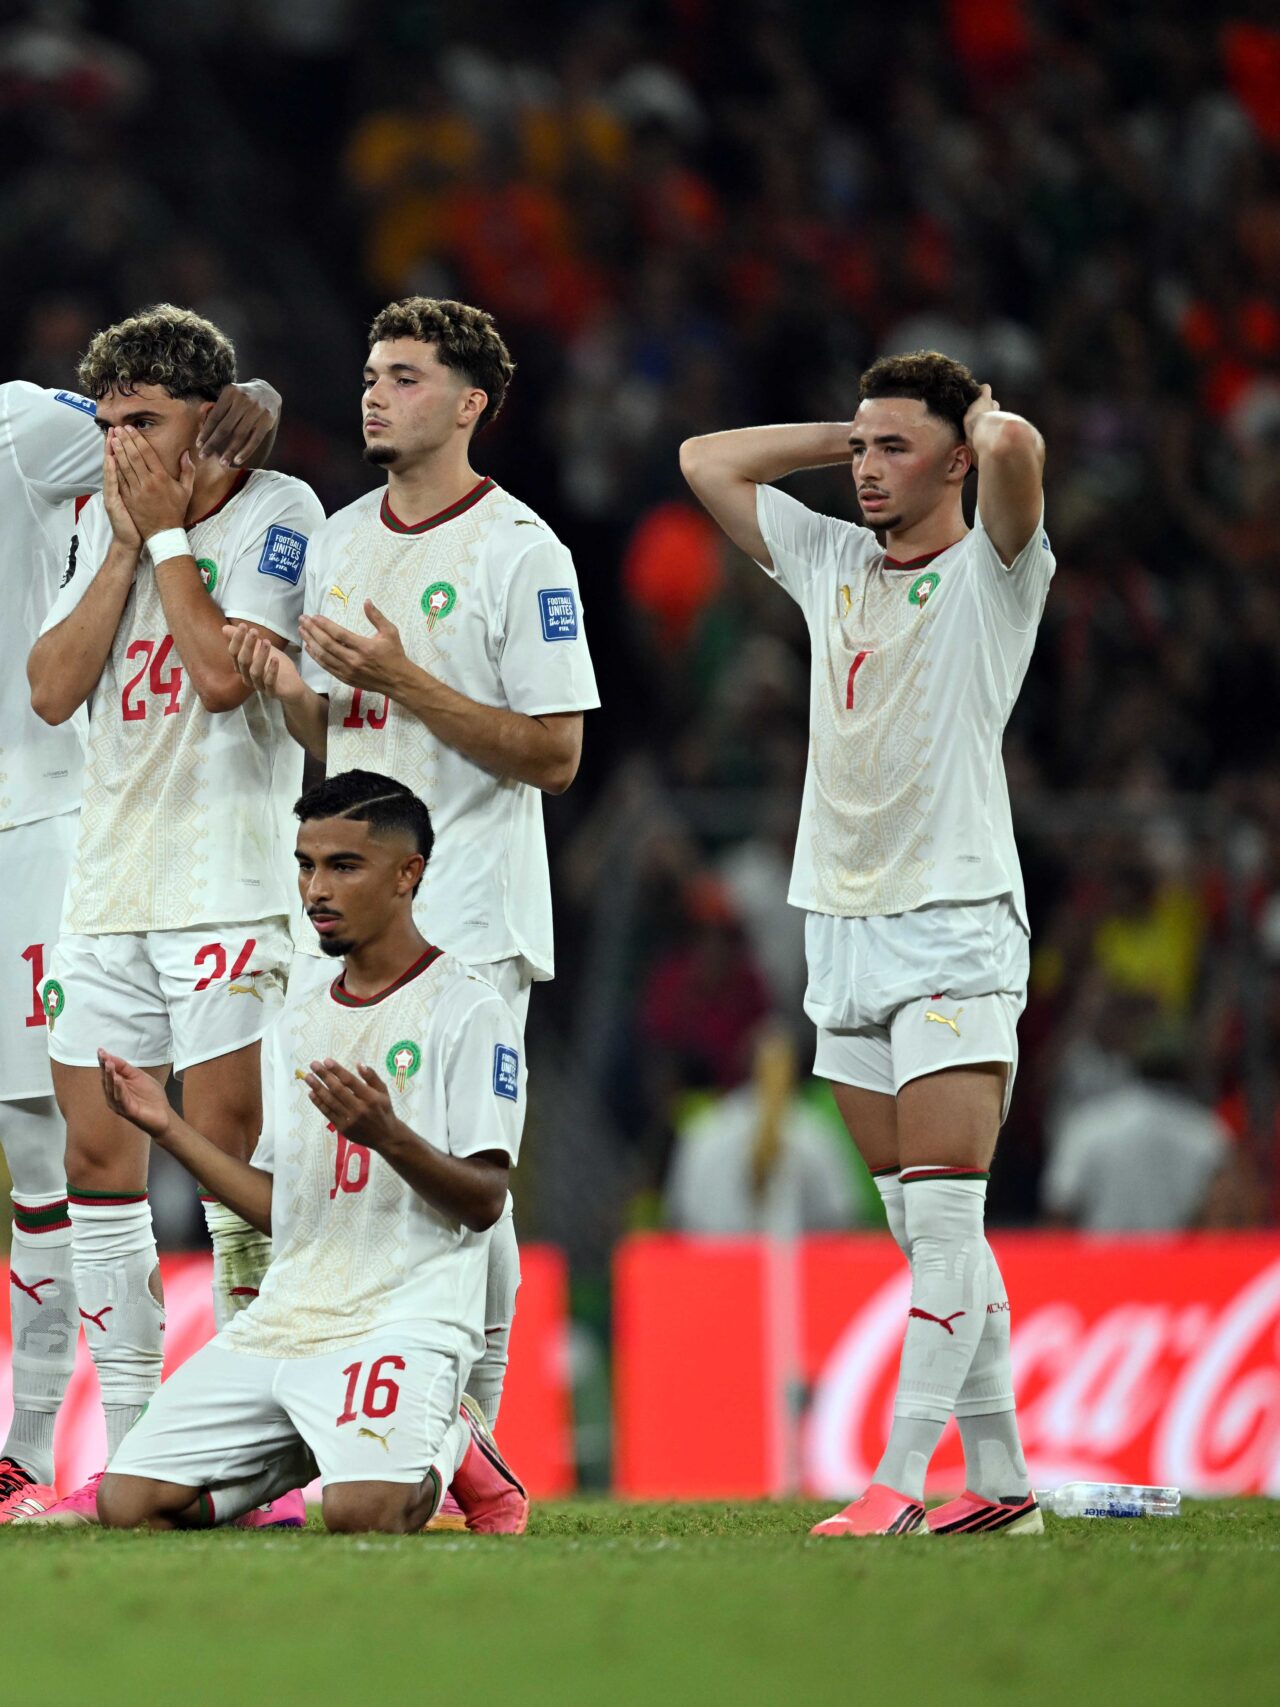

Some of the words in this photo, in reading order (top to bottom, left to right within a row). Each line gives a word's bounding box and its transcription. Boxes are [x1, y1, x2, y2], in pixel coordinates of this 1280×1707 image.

[276, 535, 302, 551] FOOTBALL
[273, 542, 300, 561] UNITES
[269, 553, 279, 562] the
[280, 555, 300, 570] World
[547, 597, 571, 605] FOOTBALL
[549, 605, 573, 616] UNITES
[121, 633, 182, 722] 24
[337, 1355, 407, 1426] 16
[1083, 1507, 1143, 1518] martwater
